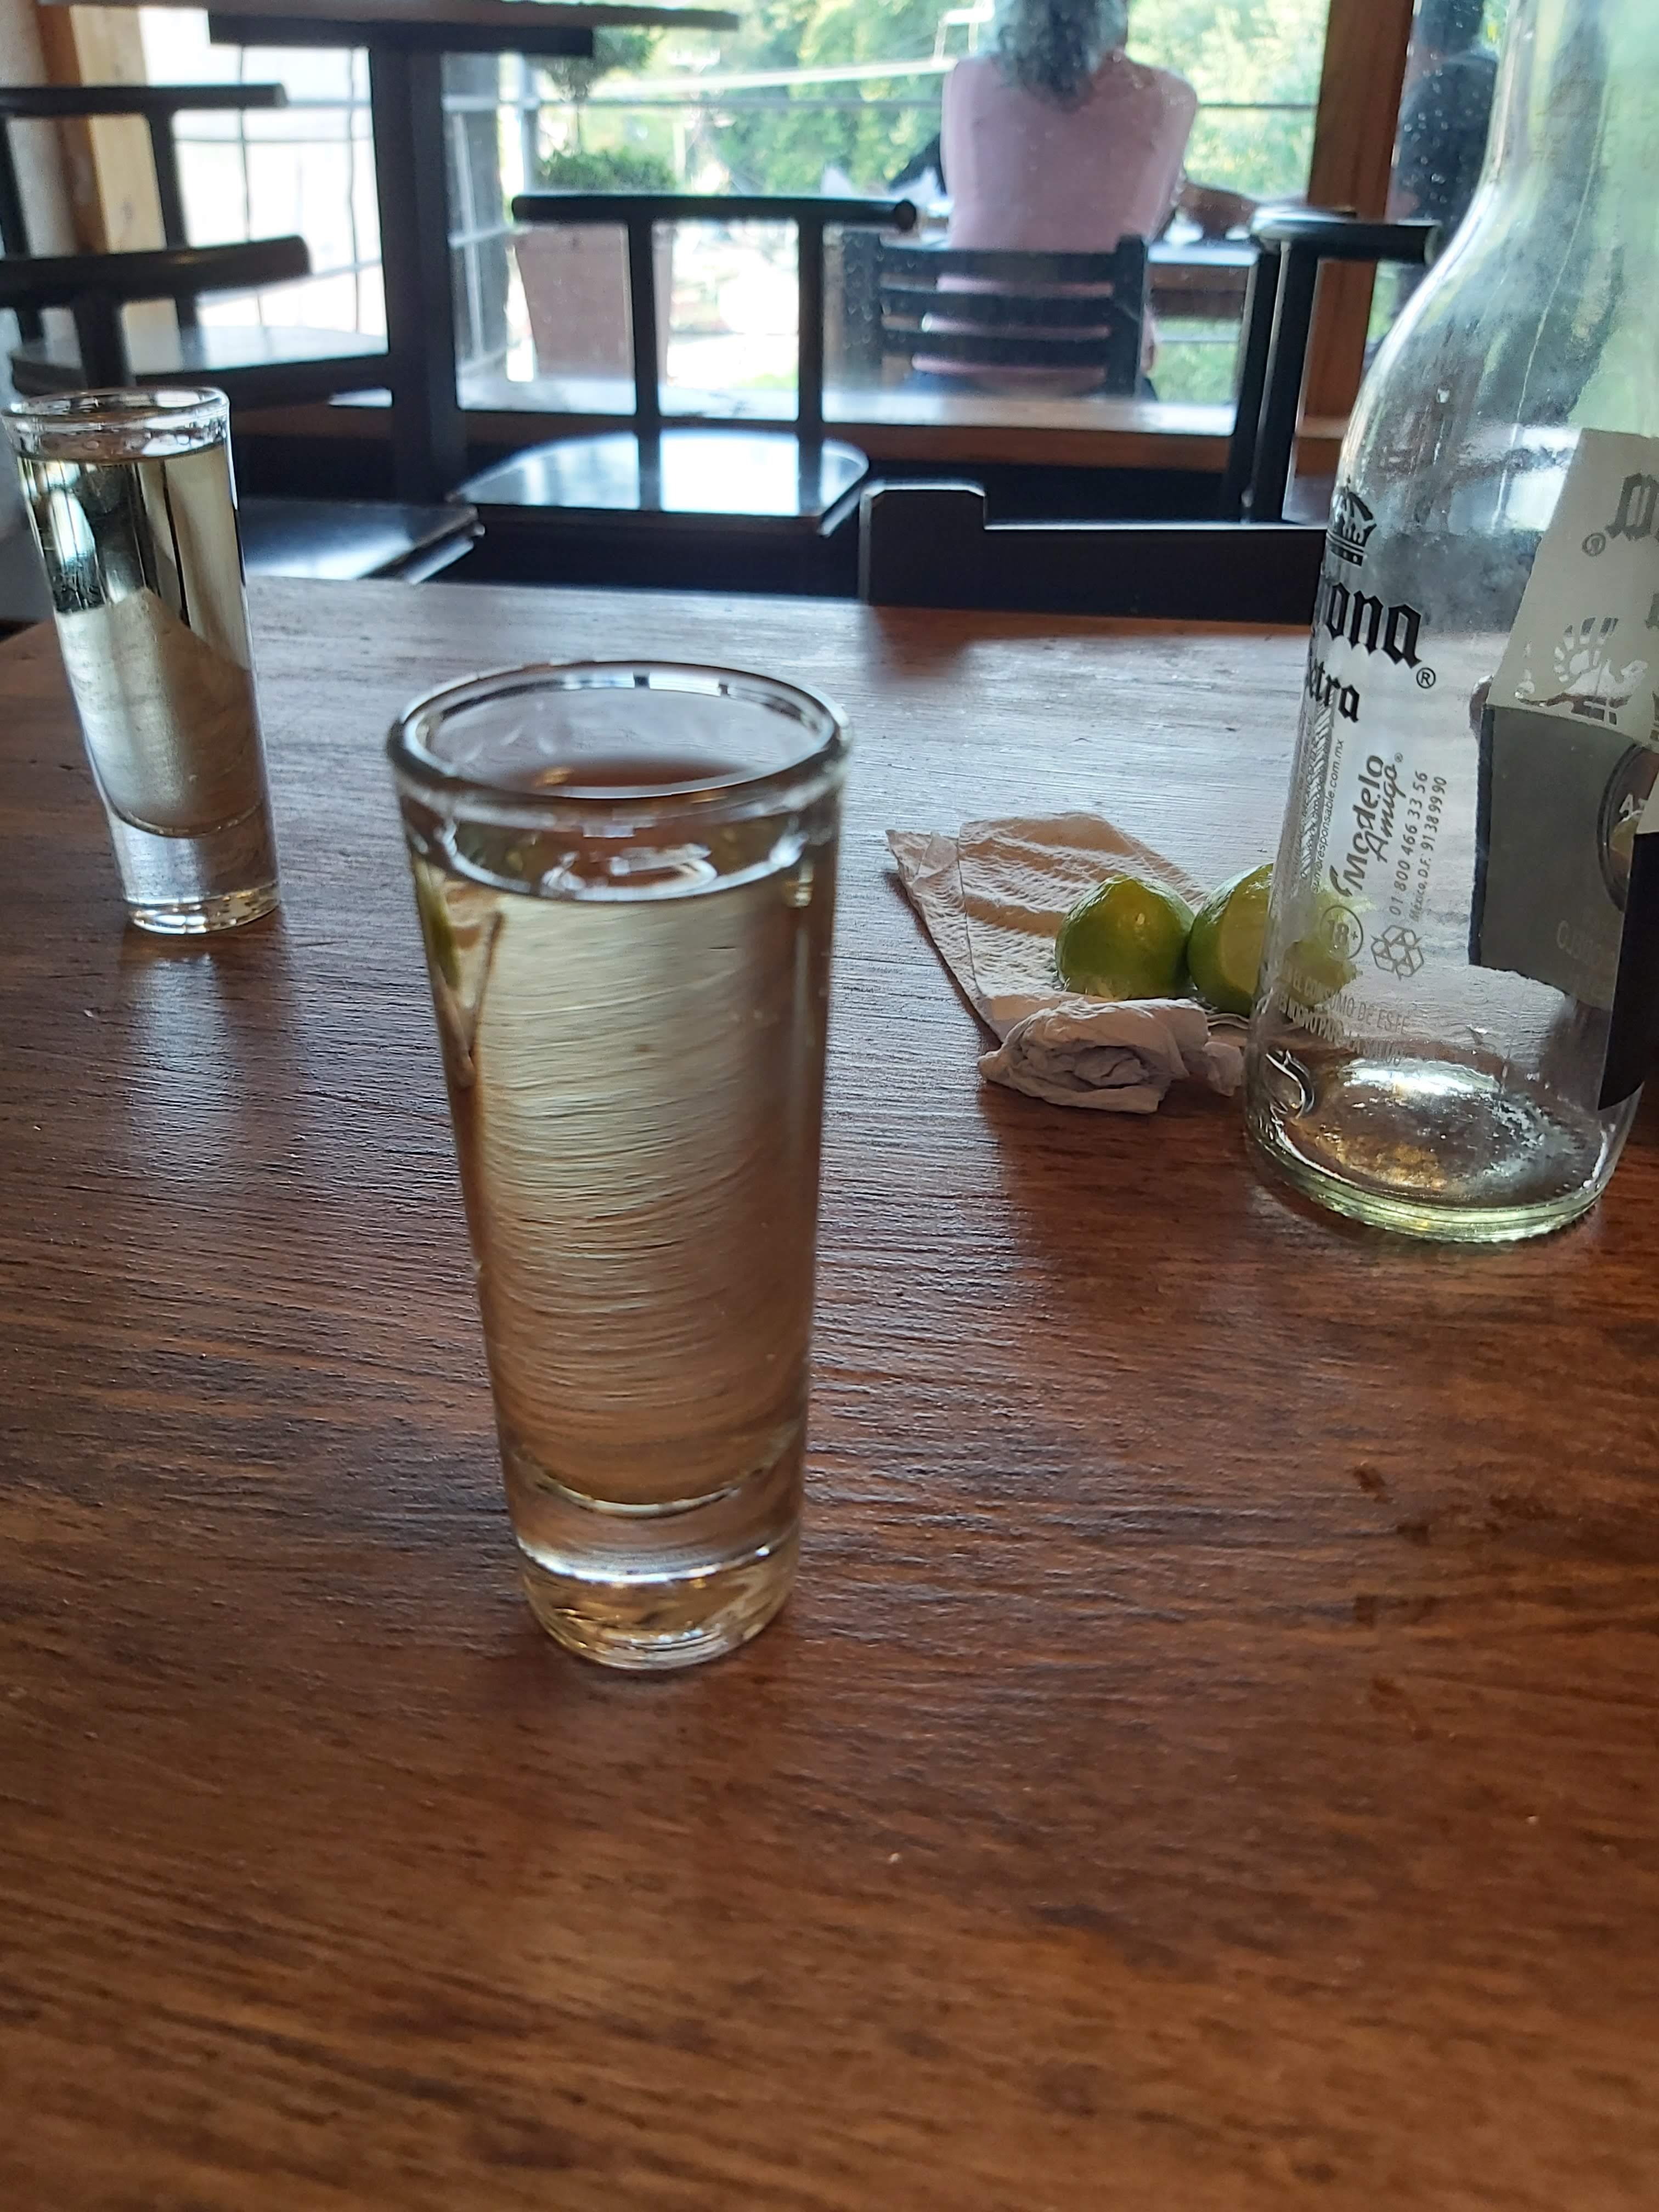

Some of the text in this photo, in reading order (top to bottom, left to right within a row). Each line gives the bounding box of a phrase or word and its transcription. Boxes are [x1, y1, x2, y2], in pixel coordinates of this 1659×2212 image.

[1343, 755, 1384, 891] Modelo
[1364, 764, 1407, 863] Amigo
[1389, 770, 1427, 916] 01 800 466 33 56
